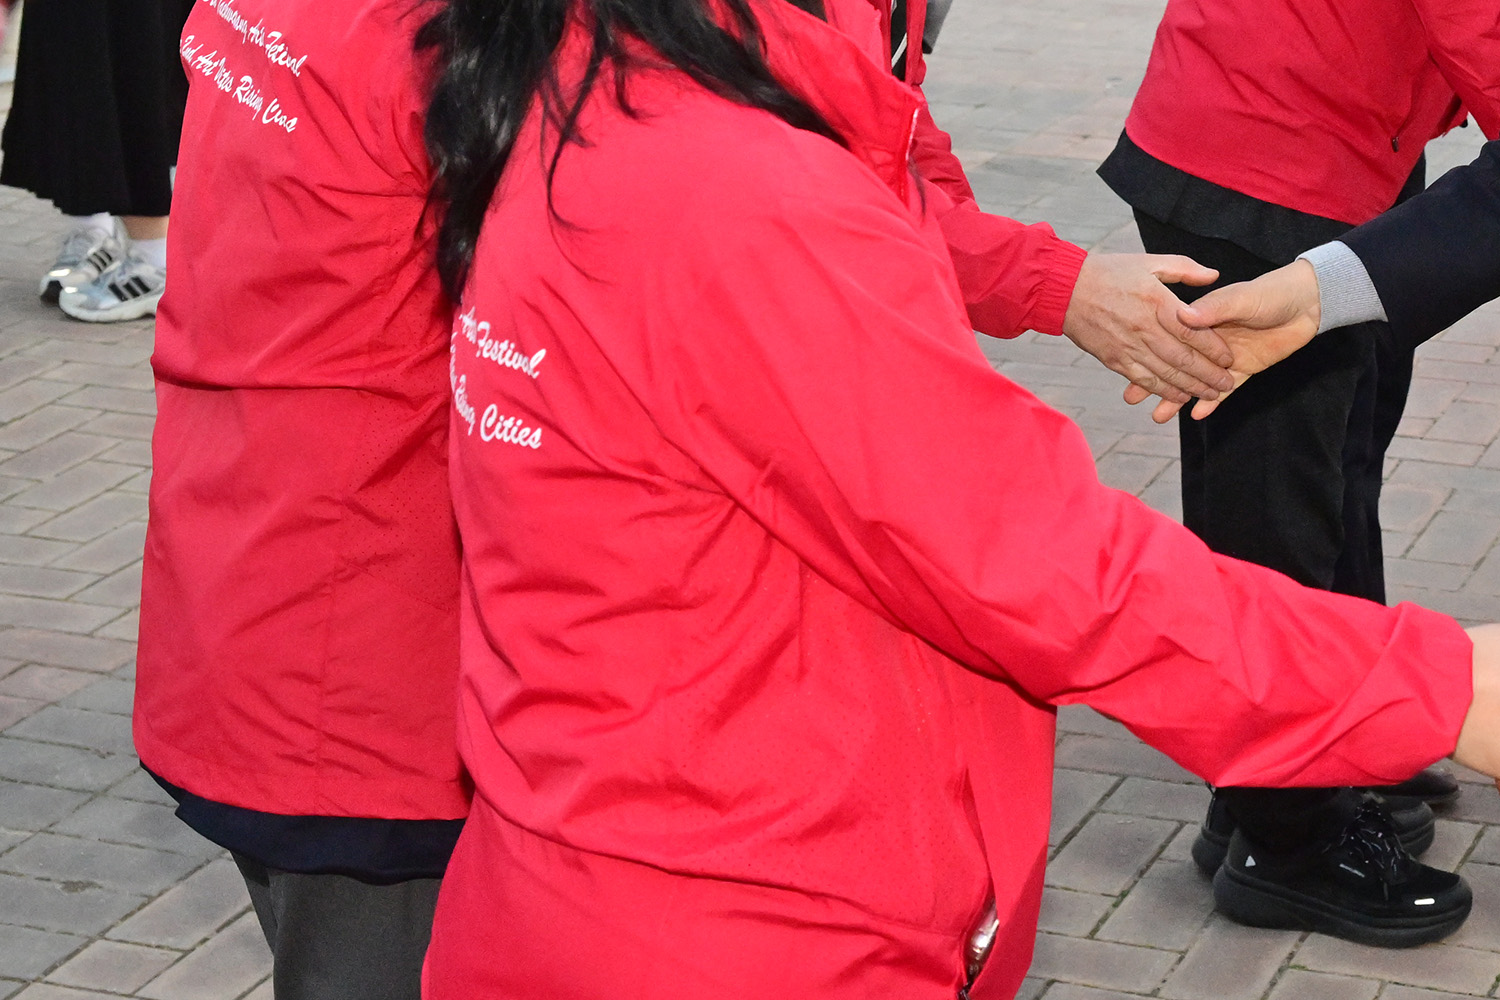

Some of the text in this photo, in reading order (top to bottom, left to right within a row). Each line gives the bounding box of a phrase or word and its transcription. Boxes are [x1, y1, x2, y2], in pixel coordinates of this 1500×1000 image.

[232, 75, 263, 120] Rising
[476, 321, 547, 379] Festival
[480, 403, 542, 449] Cities
